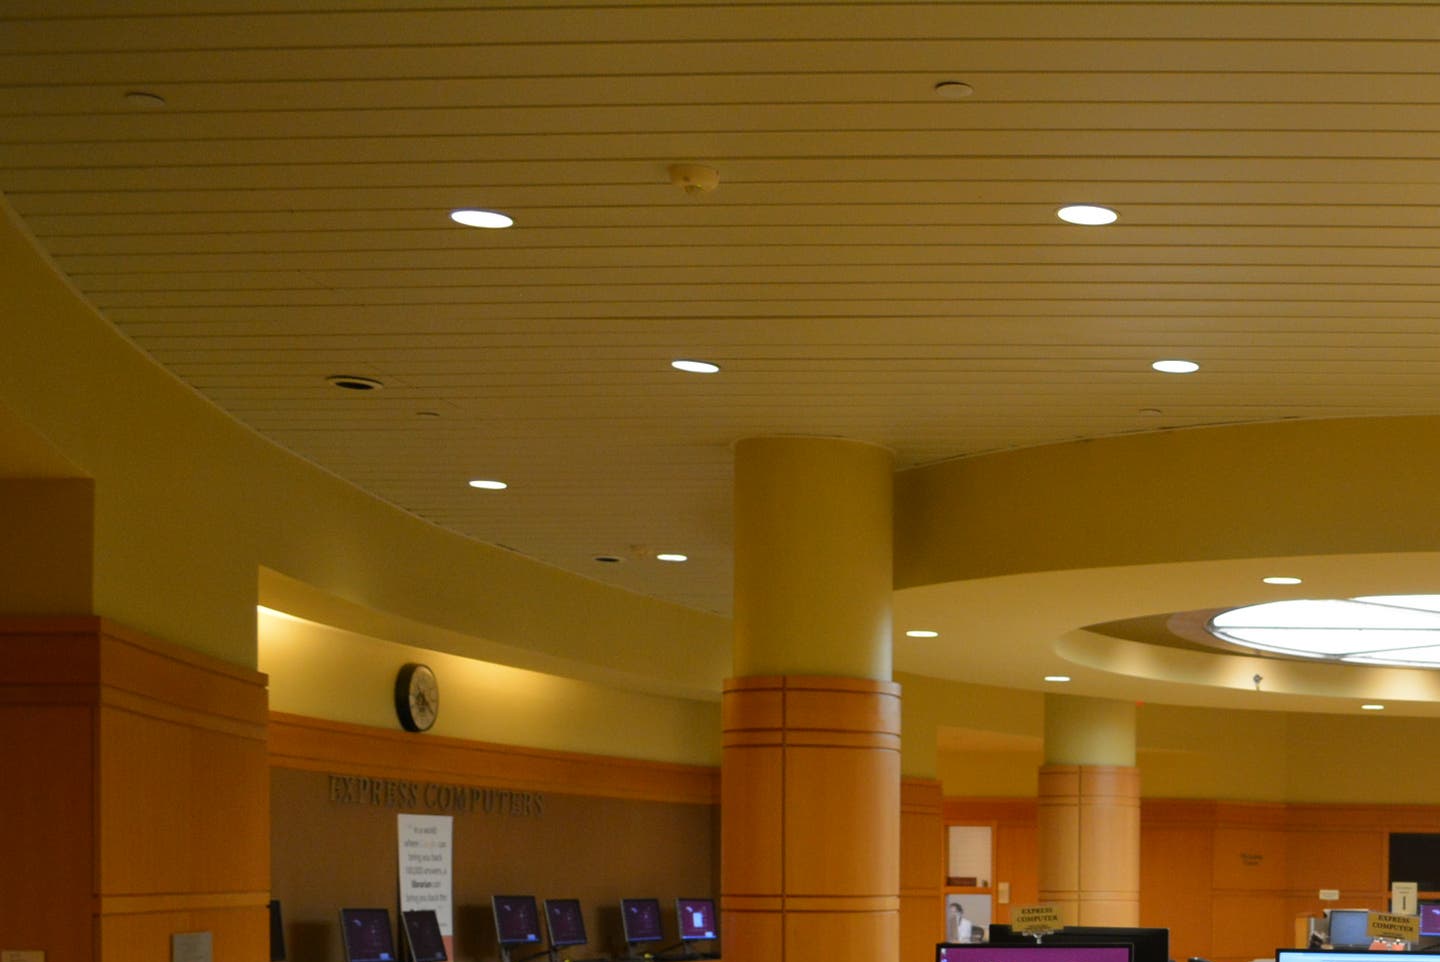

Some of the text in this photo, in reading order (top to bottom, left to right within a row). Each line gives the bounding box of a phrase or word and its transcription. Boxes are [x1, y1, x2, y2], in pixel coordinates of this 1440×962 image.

[328, 774, 545, 817] EXPRESS COMPUTERS
[1021, 907, 1053, 915] EXPRESS
[1378, 914, 1411, 924] EXPRESS
[1371, 922, 1414, 932] COMPUTER
